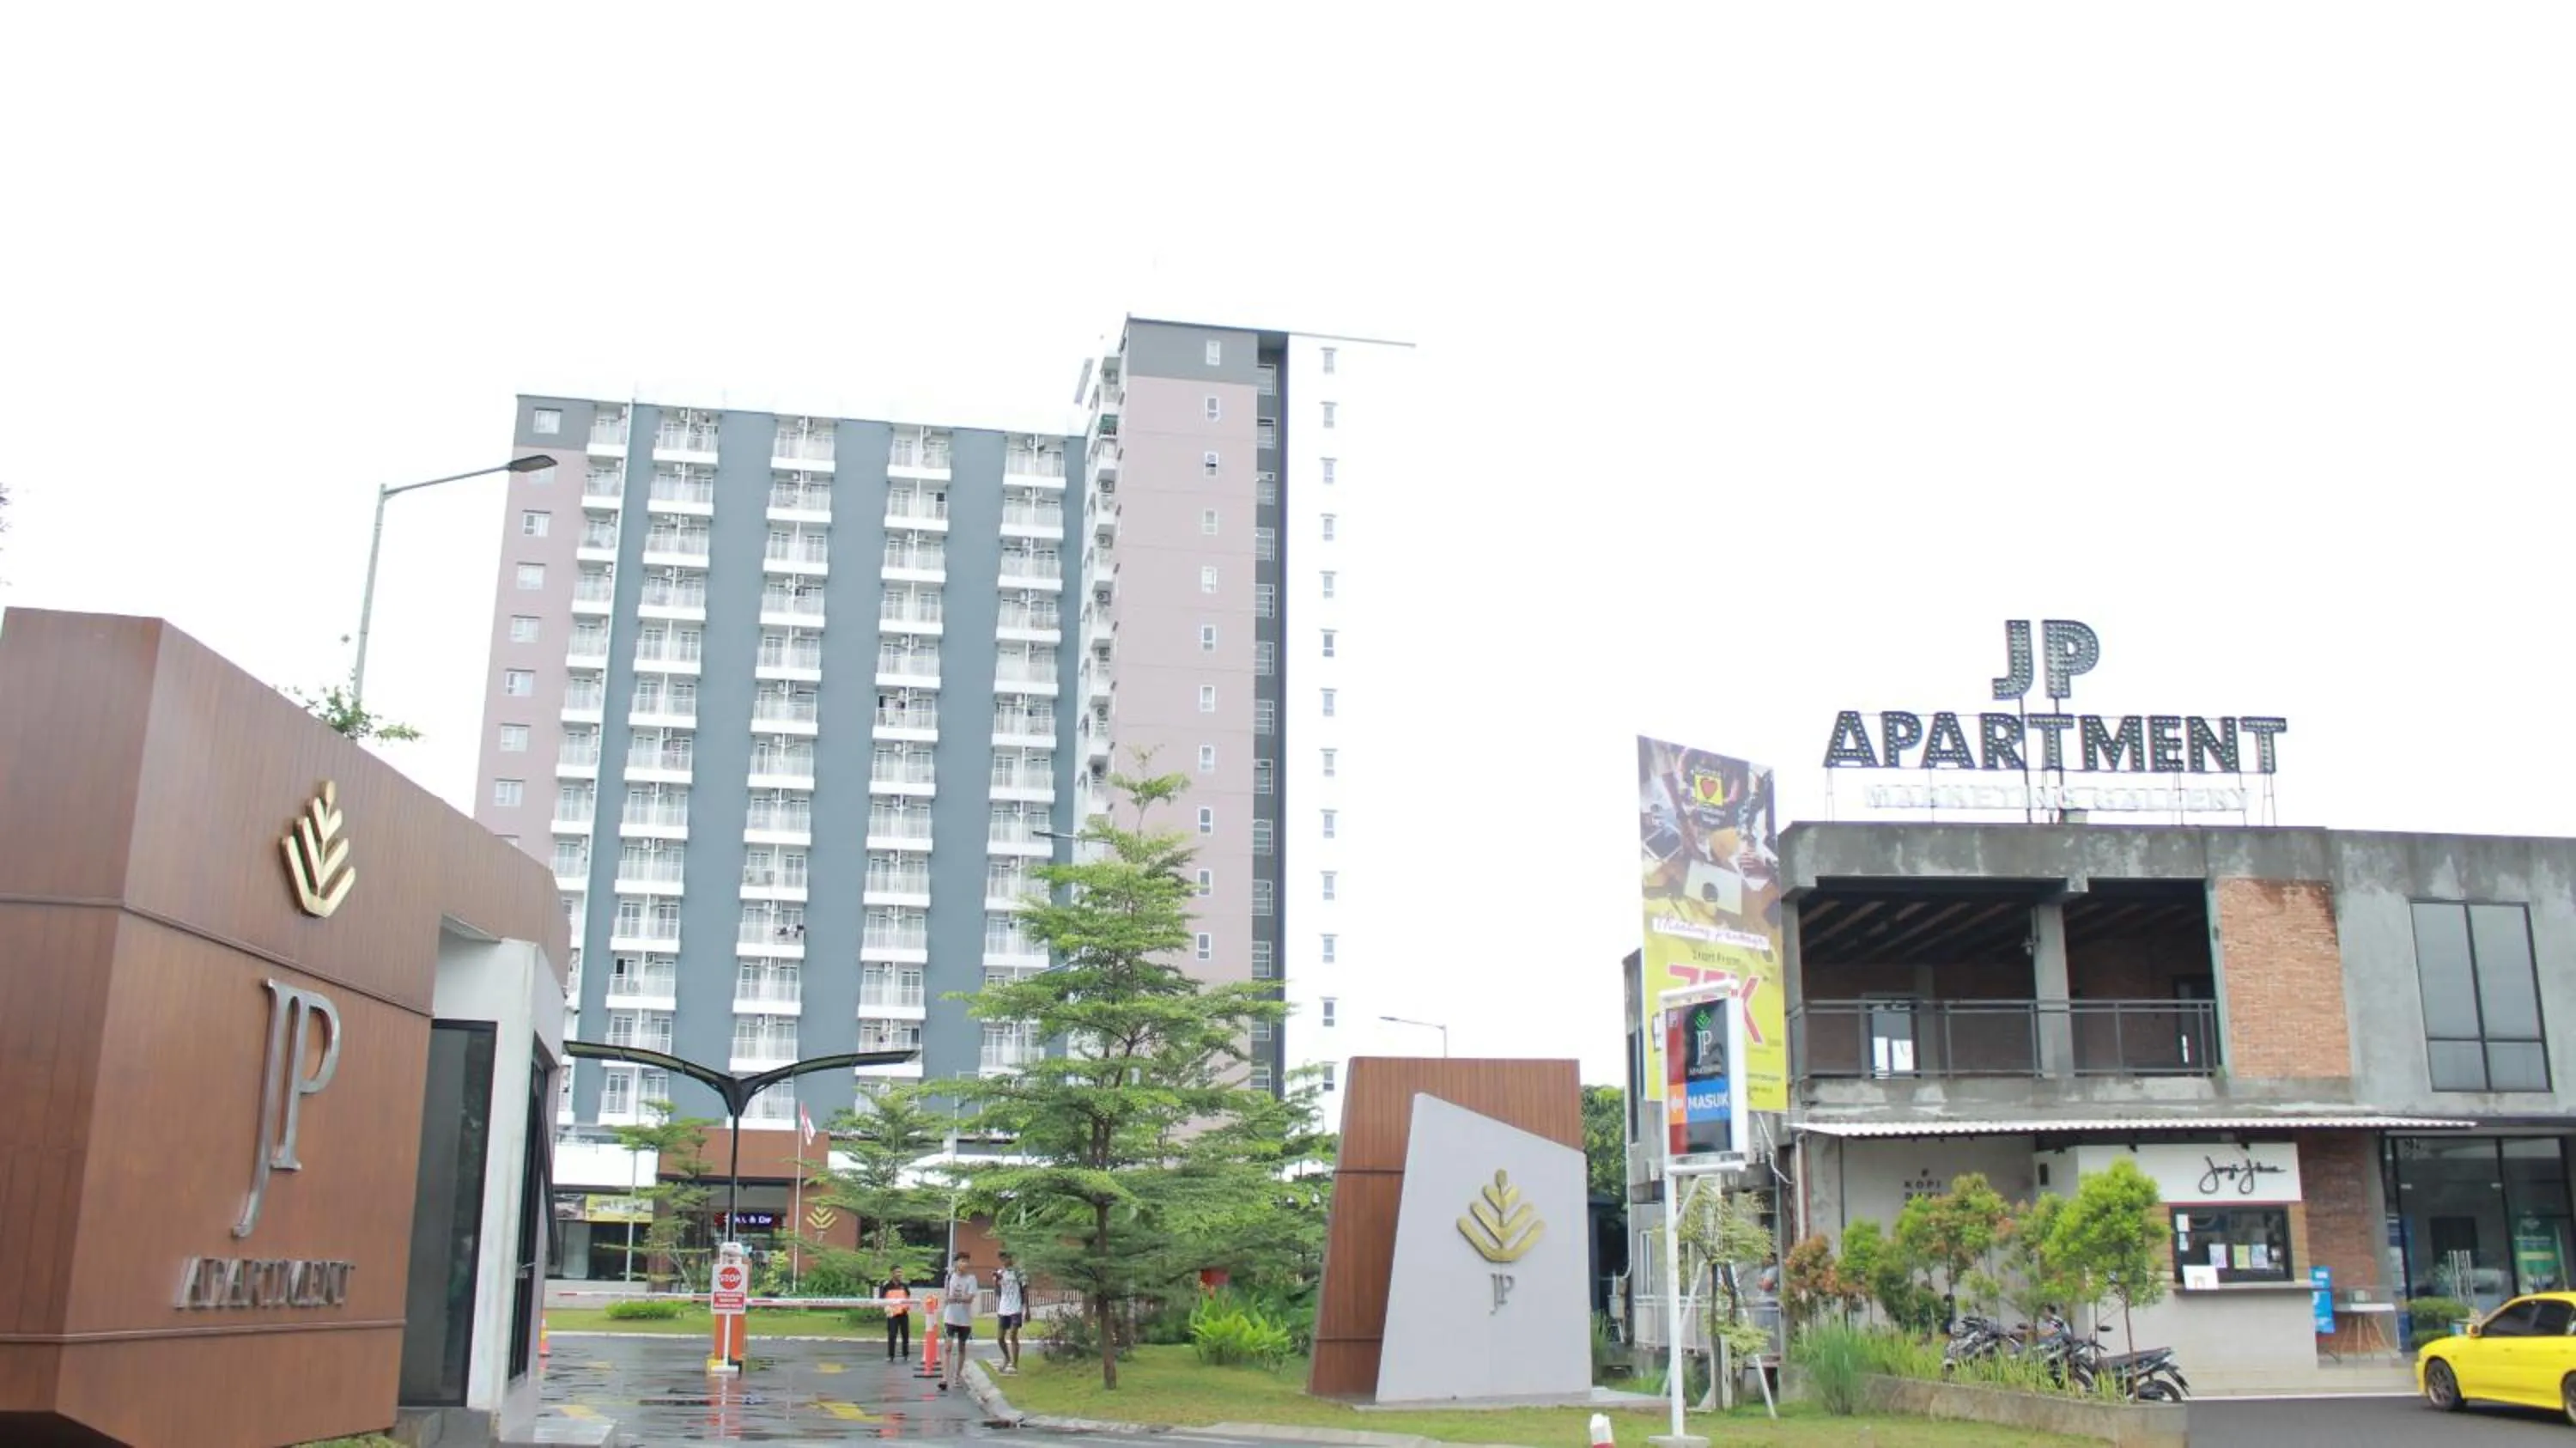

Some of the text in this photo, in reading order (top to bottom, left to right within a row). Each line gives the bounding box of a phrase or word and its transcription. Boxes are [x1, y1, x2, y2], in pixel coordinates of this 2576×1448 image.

[1992, 619, 2100, 700] JP
[1823, 710, 2287, 774] APARTMENT
[1695, 1030, 1713, 1065] JP
[230, 977, 342, 1238] JP
[1687, 1092, 1728, 1110] MASUK
[1904, 1179, 1941, 1189] KOPI
[718, 1273, 741, 1283] STOP
[1489, 1272, 1516, 1316] JP
